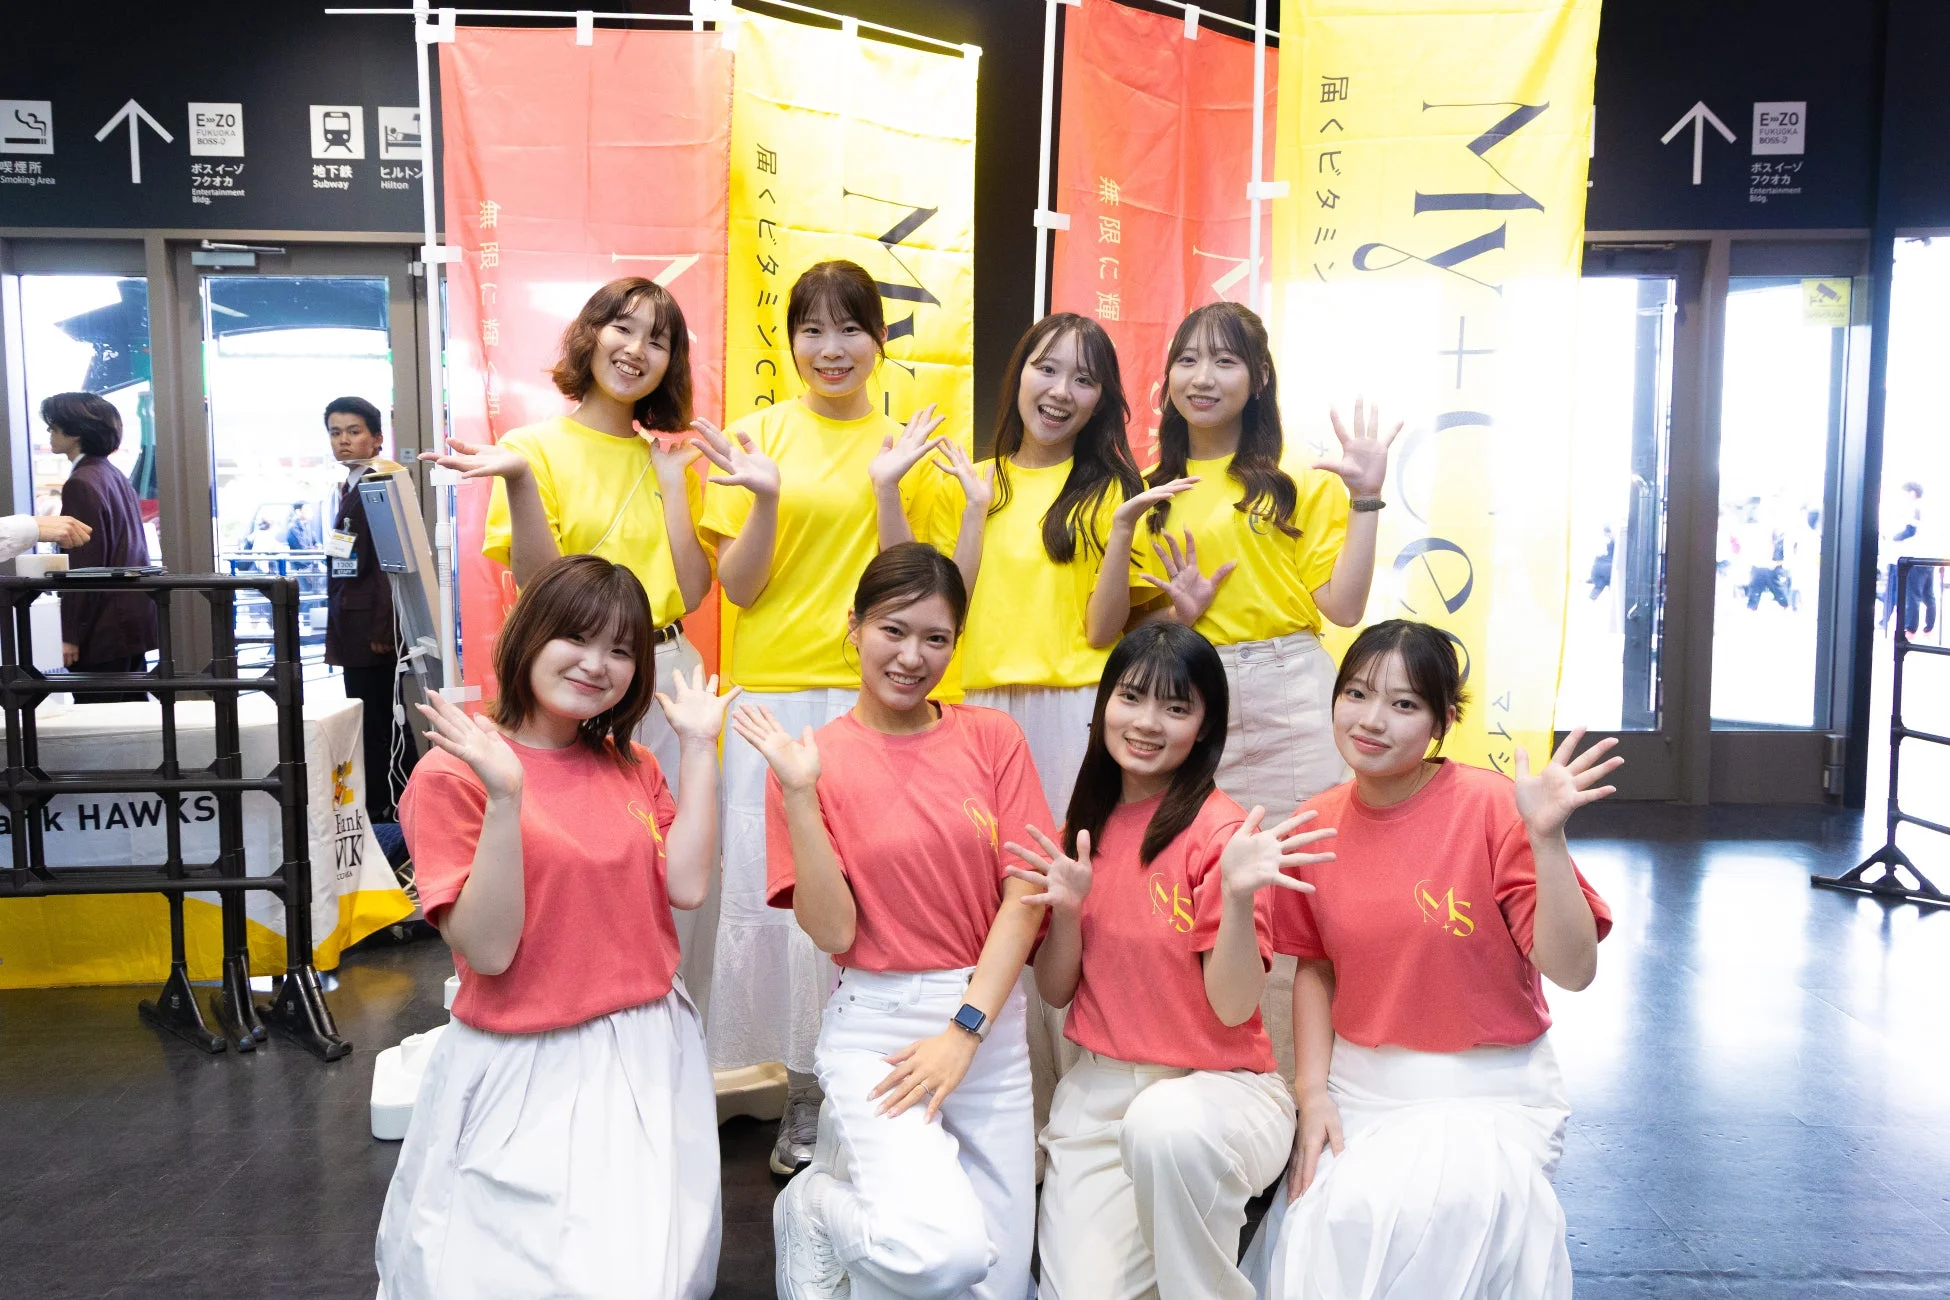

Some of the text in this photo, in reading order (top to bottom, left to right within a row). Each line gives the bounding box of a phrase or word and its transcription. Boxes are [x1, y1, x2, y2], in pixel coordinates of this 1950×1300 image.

[312, 164, 353, 178] 地下鉄
[380, 166, 424, 179] ヒルトン
[0, 176, 36, 186] Smoking
[191, 176, 234, 187] フクオカ
[312, 179, 349, 190] Subway
[380, 180, 409, 190] Hilton
[1751, 174, 1791, 185] フクオカ
[191, 188, 245, 197] Entertainment
[1749, 187, 1802, 195] Entertainment
[1094, 175, 1120, 348] 無限に輝
[1151, 881, 1194, 933] MS
[1421, 886, 1475, 937] MS
